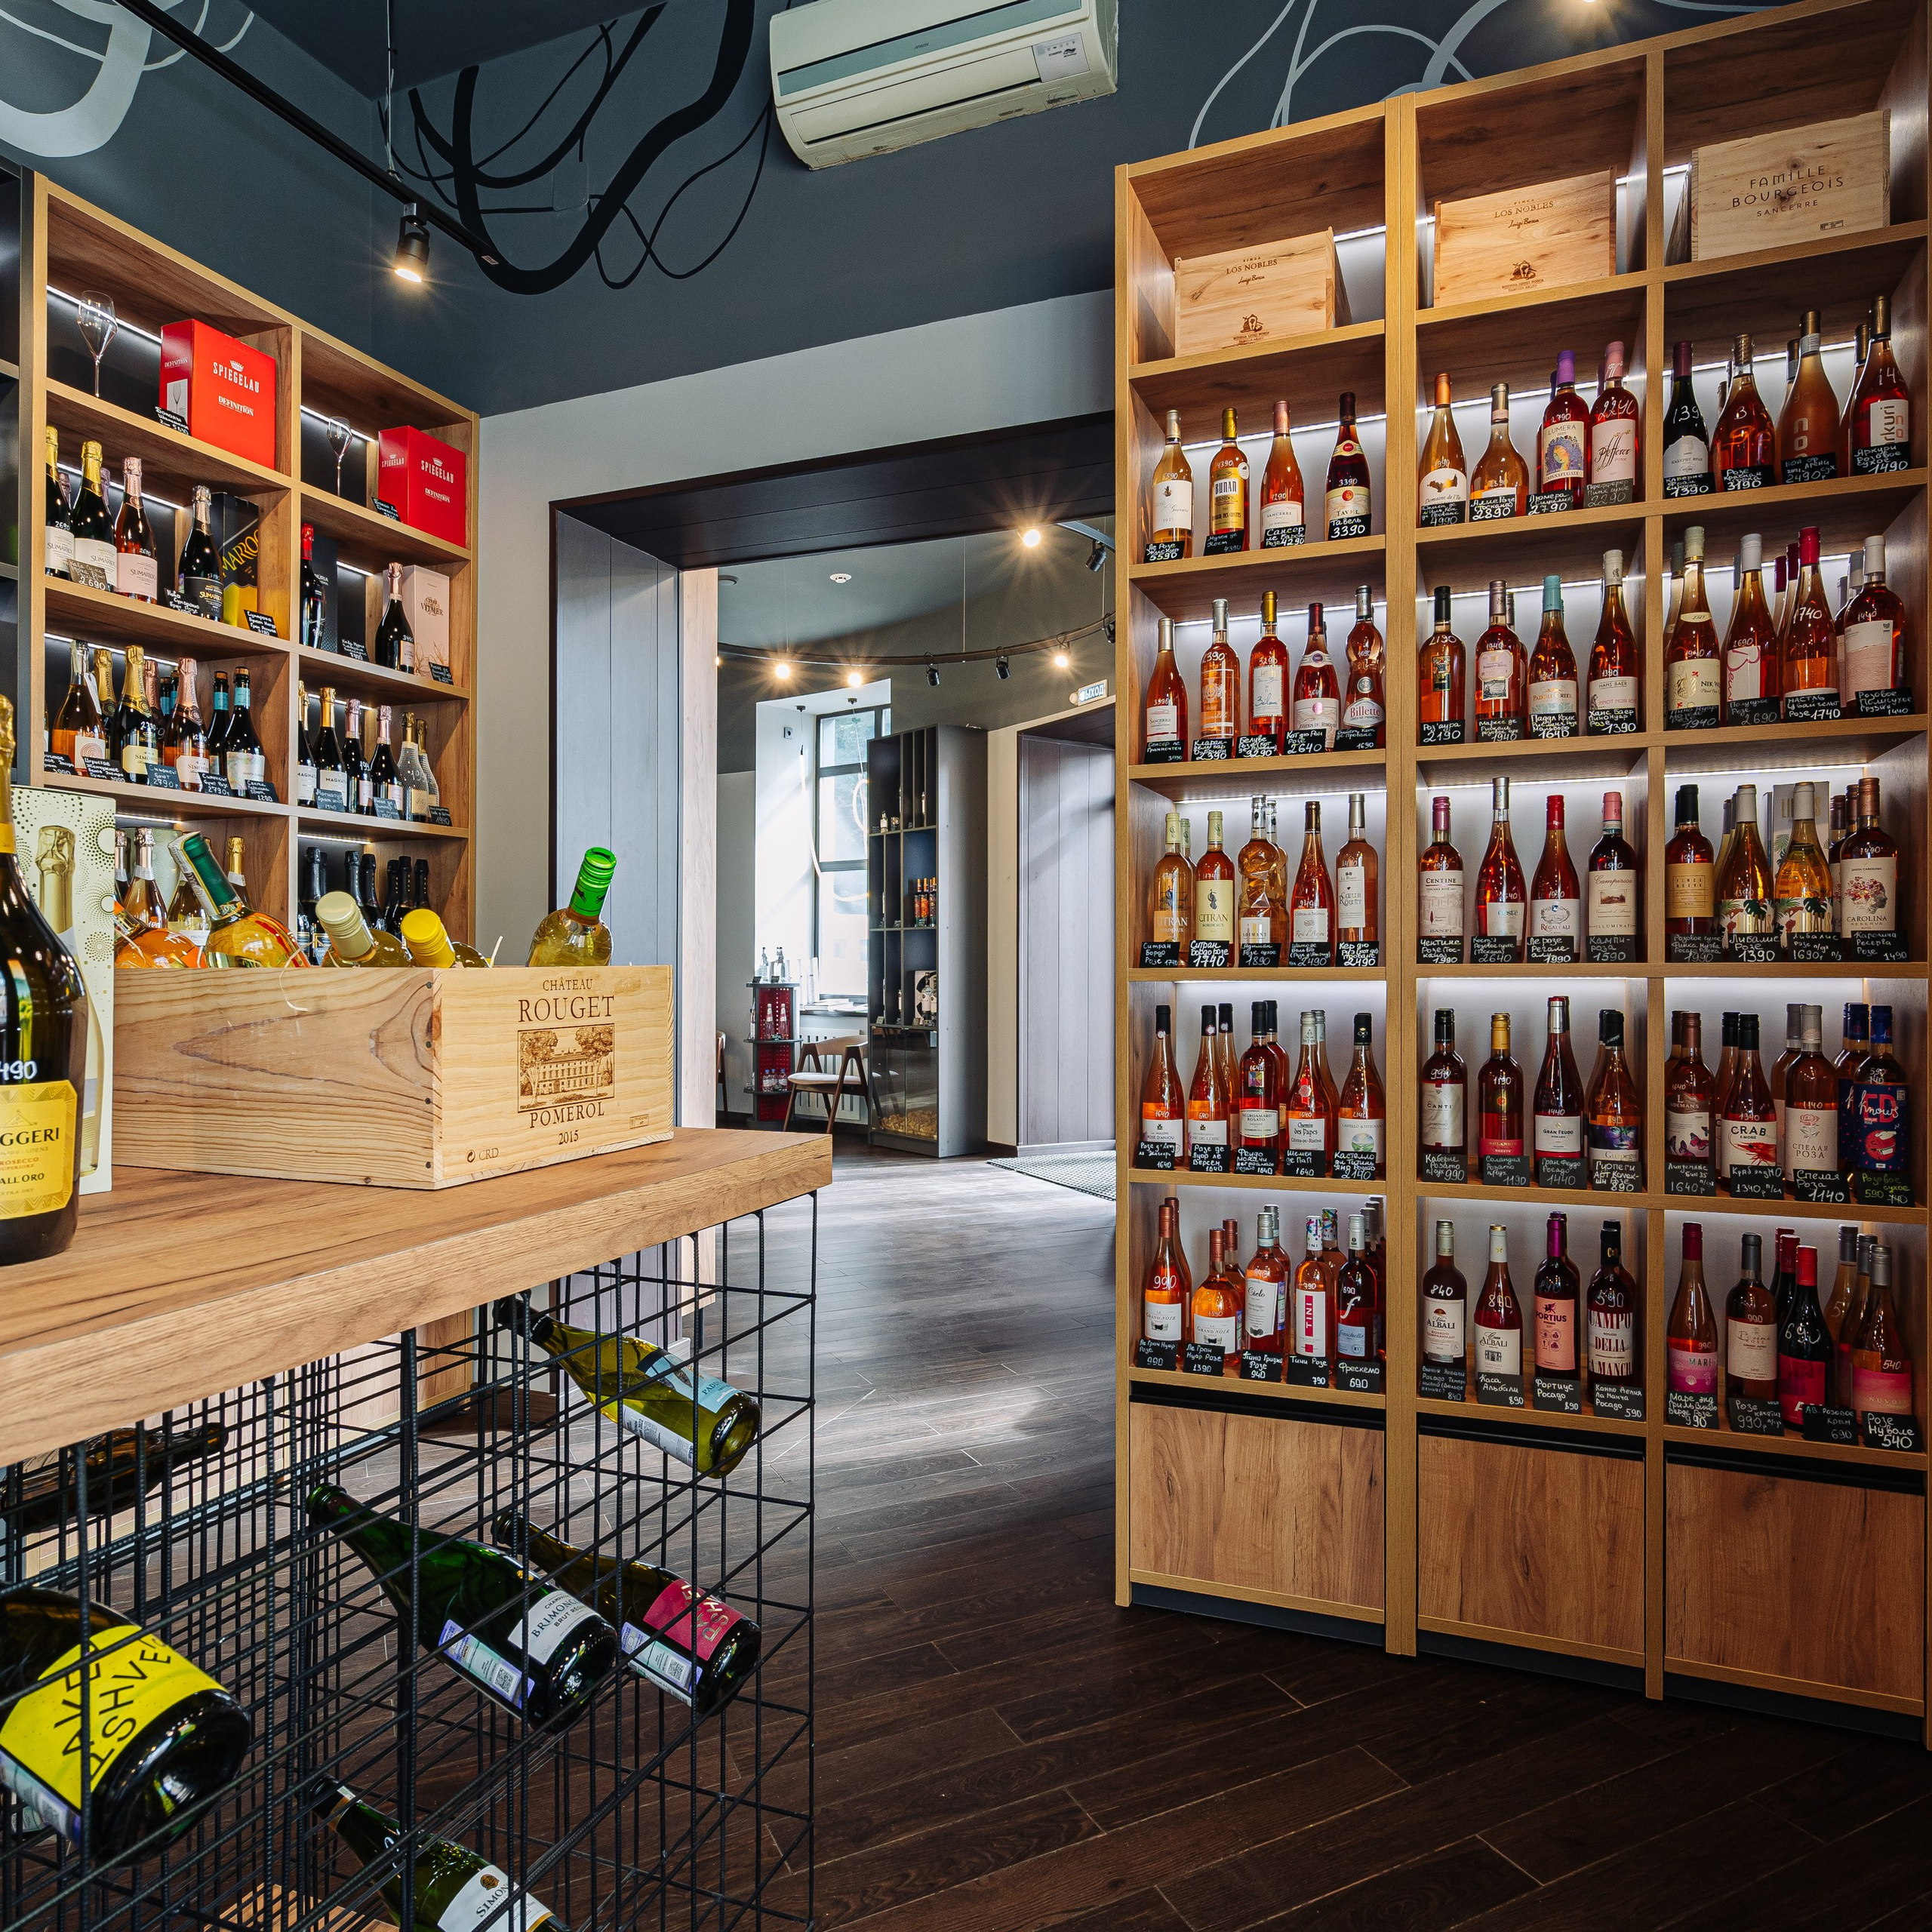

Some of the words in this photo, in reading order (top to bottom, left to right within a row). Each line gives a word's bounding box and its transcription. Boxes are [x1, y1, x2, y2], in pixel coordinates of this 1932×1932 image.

[1751, 165, 1825, 189] FAMILLE
[1733, 177, 1843, 207] BOURGEOIS
[1494, 210, 1512, 218] LOS
[1515, 201, 1553, 214] NOBLES
[1757, 200, 1819, 217] SANCERRE
[1226, 266, 1242, 275] LOS
[1244, 259, 1278, 271] NOBLES
[165, 358, 188, 368] DEFINITION
[213, 362, 260, 393] SPIEGELAU
[219, 395, 254, 416] DEFINITION
[1548, 424, 1576, 435] LUMERA
[382, 458, 404, 467] SPIEGELAU
[1868, 461, 1908, 474] 1490
[421, 460, 454, 483] SPIEGELAU
[1786, 472, 1820, 483] 2490
[1215, 481, 1237, 493] BUNAN
[1672, 485, 1709, 497] 1390
[1727, 480, 1761, 491] 3190
[426, 488, 450, 503] DEFINITION
[1588, 492, 1626, 507] 2290
[1472, 509, 1510, 520] 2890
[1528, 503, 1567, 515] 2790
[1331, 525, 1365, 537] 3390
[1149, 552, 1177, 561] 5590
[79, 577, 106, 591] 2690
[1792, 607, 1822, 623] 1740
[1349, 707, 1380, 716] Billette
[1811, 708, 1841, 719] 1740
[1682, 718, 1716, 729] 1940
[1742, 712, 1777, 726] 2690
[1602, 722, 1636, 733] 1390
[1423, 730, 1460, 742] 2190
[1539, 729, 1569, 738] 1640
[1287, 743, 1321, 754] 2640
[154, 779, 173, 787] 2790
[1595, 875, 1633, 885] Campirosa
[1199, 913, 1228, 923] CITRAN
[1478, 954, 1511, 962] 2640
[1546, 955, 1571, 963] 1990
[1595, 952, 1626, 961] 1590
[1684, 952, 1713, 962] 1990
[1739, 950, 1775, 962] 1390
[1793, 950, 1819, 960] 1690
[1884, 952, 1907, 960] 1490
[1193, 955, 1224, 968] 1740
[1245, 958, 1270, 966] 1890
[1295, 958, 1327, 967] 2490
[543, 977, 592, 991] CHÂTEAU
[518, 995, 614, 1023] ROUGET
[1431, 1069, 1451, 1079] 990
[1803, 1100, 1823, 1109] 1140
[1859, 1091, 1898, 1119] knows
[530, 1102, 605, 1128] POMEROL
[1730, 1126, 1767, 1136] CRAB
[558, 1130, 579, 1146] 2015
[478, 1147, 499, 1161] CRD
[1796, 1150, 1825, 1158] РОЗА
[1297, 1168, 1314, 1177] 1640
[1342, 1169, 1371, 1180] 2140
[1444, 1170, 1464, 1181] 990
[1503, 1177, 1526, 1186] 1190
[1546, 1176, 1576, 1186] 1440
[1671, 1181, 1698, 1192] 1640
[1611, 1183, 1634, 1192] 890
[1736, 1182, 1760, 1192] 1340
[1809, 1189, 1844, 1201] 1140
[1865, 1189, 1884, 1198] 590
[1154, 1275, 1177, 1290] 990
[1247, 1287, 1265, 1297] Cielo
[1343, 1286, 1355, 1294] 690
[1431, 1284, 1453, 1296] 840
[1536, 1312, 1567, 1322] FORTIUS
[1589, 1312, 1632, 1330] CAMPO
[1480, 1338, 1507, 1347] ALBALI
[1595, 1337, 1626, 1352] DELIA
[1147, 1357, 1163, 1366] 990
[1689, 1358, 1712, 1367] MARE
[1883, 1360, 1901, 1369] 540
[1192, 1364, 1211, 1373] 1390
[1251, 1370, 1266, 1378] 940
[1312, 1377, 1325, 1385] 790
[1349, 1378, 1367, 1388] 690
[1509, 1396, 1524, 1405] 890
[1564, 1402, 1578, 1411] 890
[1625, 1409, 1641, 1418] 590
[1685, 1415, 1706, 1427] 990
[1737, 1416, 1761, 1428] 990
[1831, 1429, 1852, 1438] 690
[1883, 1435, 1912, 1448] 540
[554, 1612, 570, 1626] BRUT
